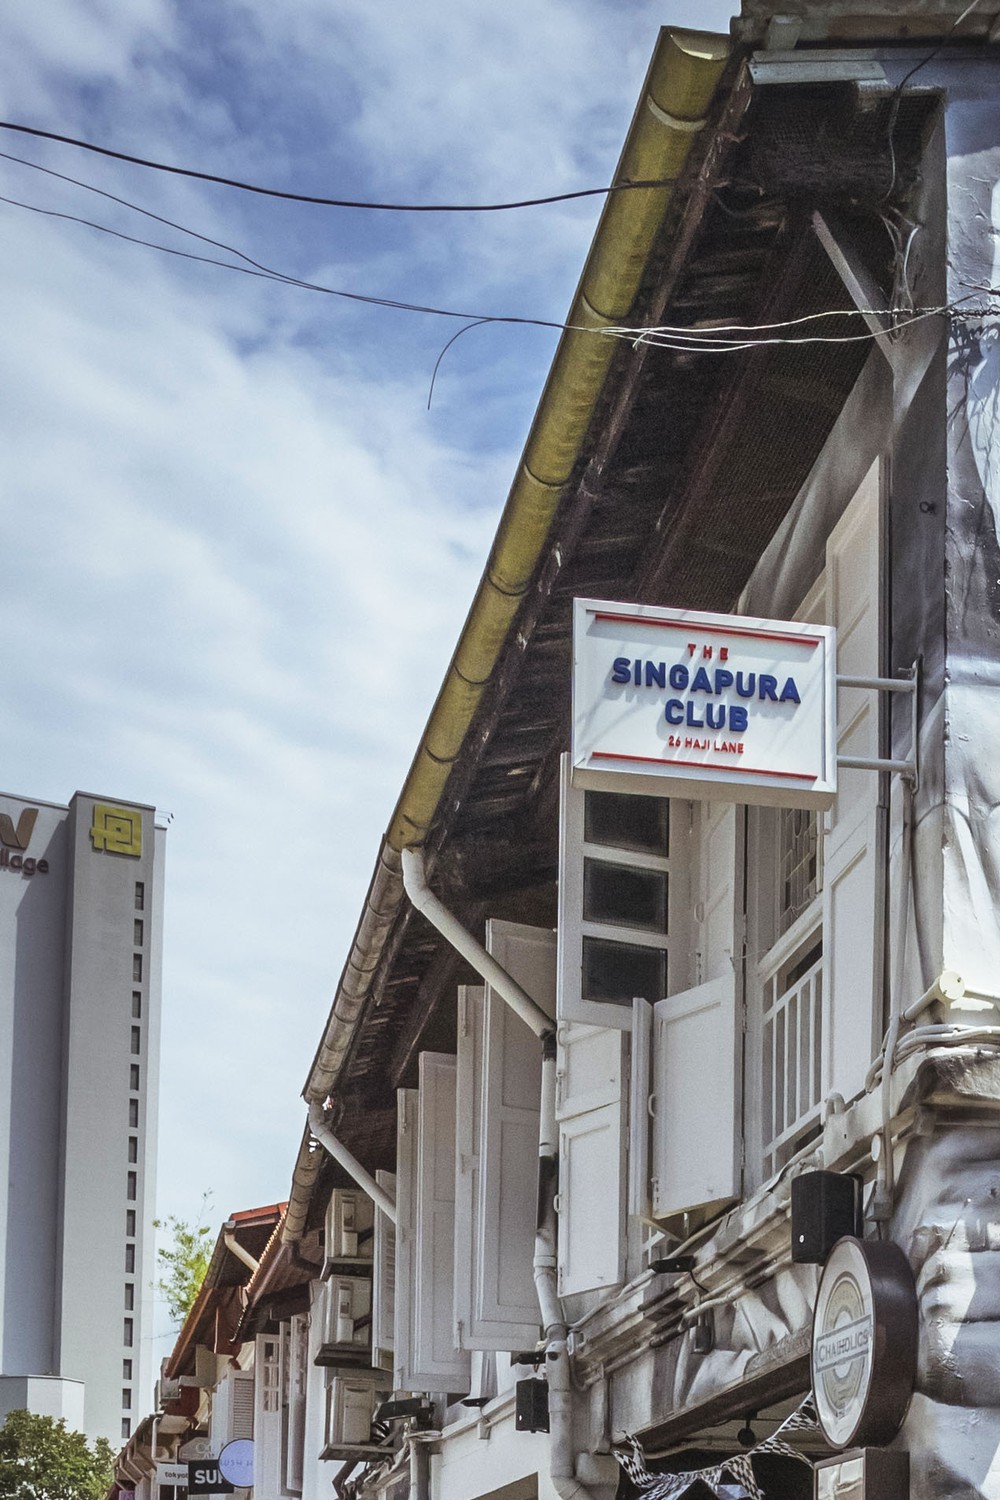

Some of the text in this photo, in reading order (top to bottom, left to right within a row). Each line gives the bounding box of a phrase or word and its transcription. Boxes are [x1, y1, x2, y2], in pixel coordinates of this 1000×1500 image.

[687, 643, 729, 660] THE
[611, 657, 801, 704] SINGAPURA
[664, 699, 749, 732] CLUB
[668, 735, 745, 754] 26 HAJI LANE
